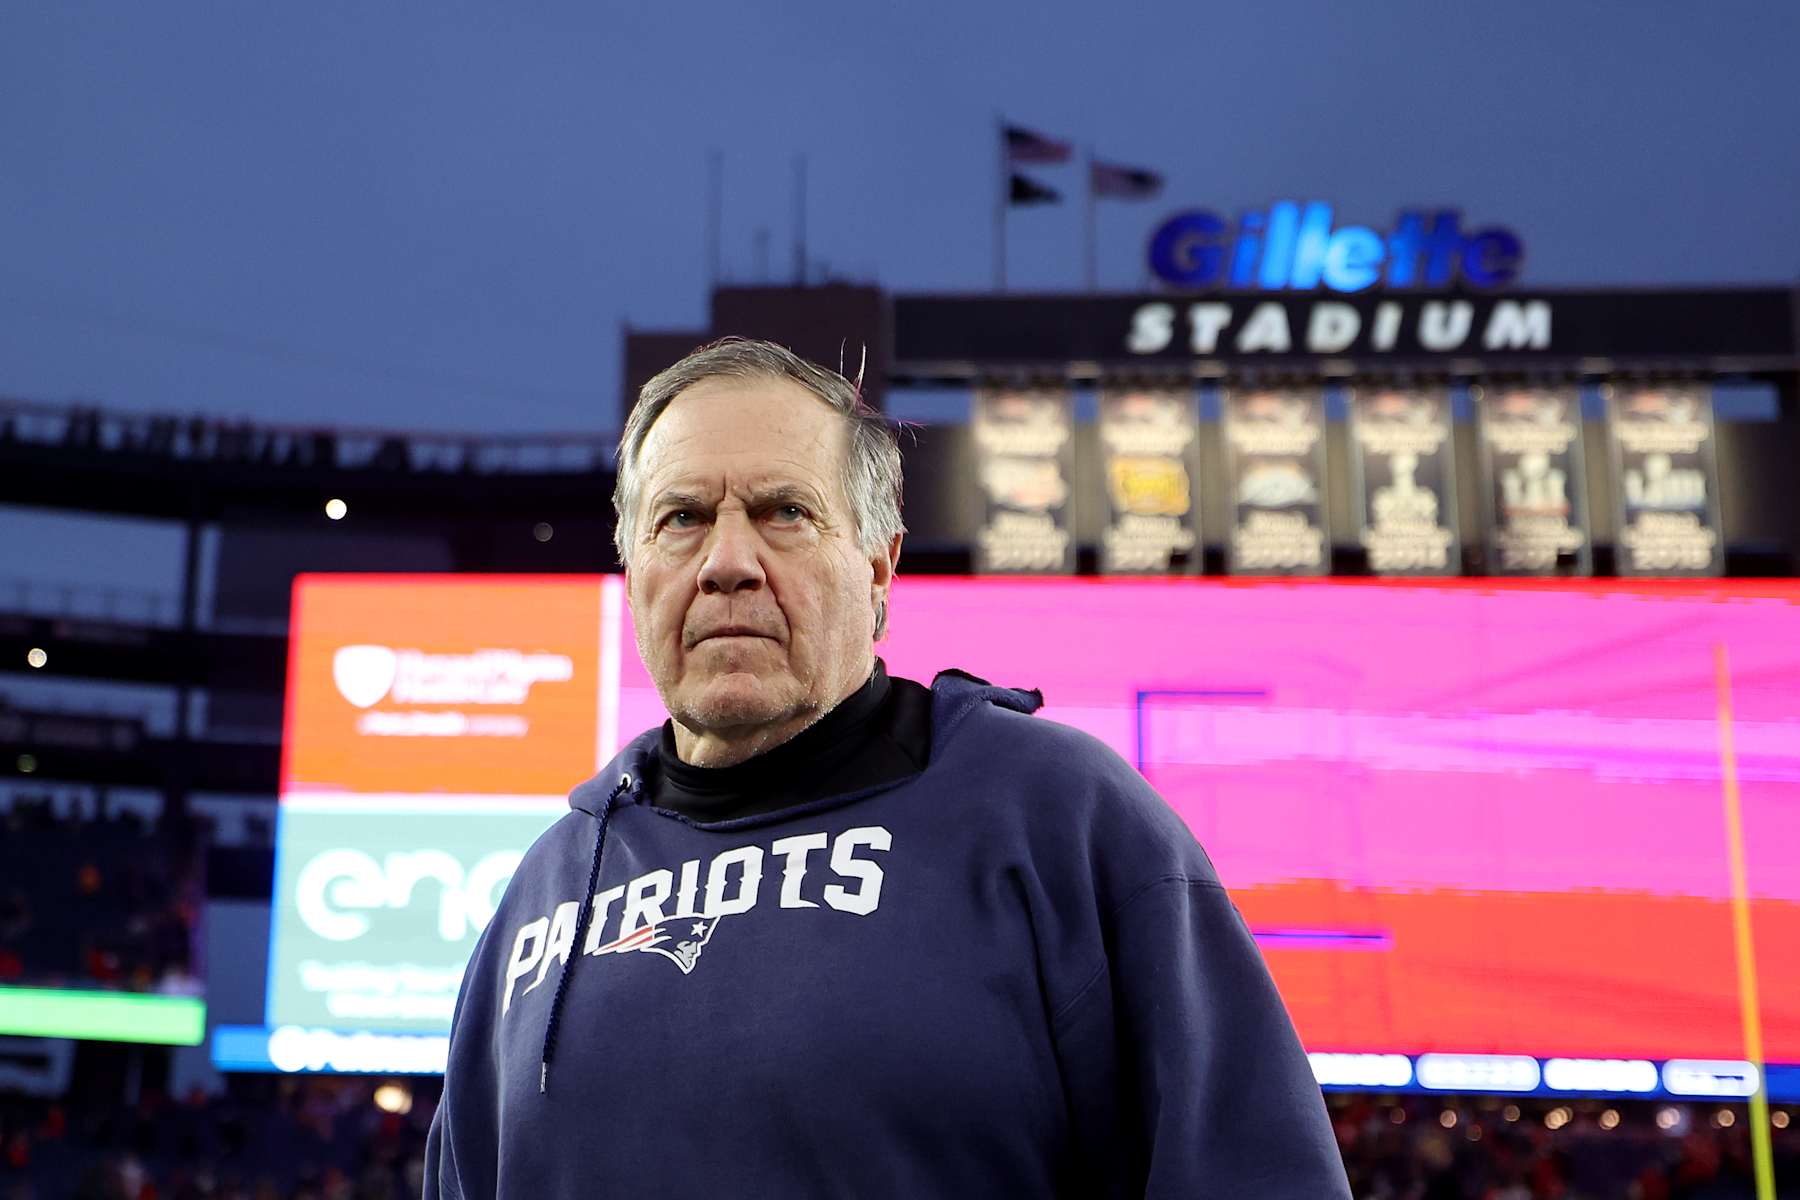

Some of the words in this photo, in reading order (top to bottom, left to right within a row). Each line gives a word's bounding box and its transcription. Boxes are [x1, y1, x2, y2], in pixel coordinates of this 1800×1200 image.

[1149, 201, 1523, 291] Gillette
[1128, 302, 1552, 354] STADIUM
[503, 826, 892, 1018] PATRIOTS
